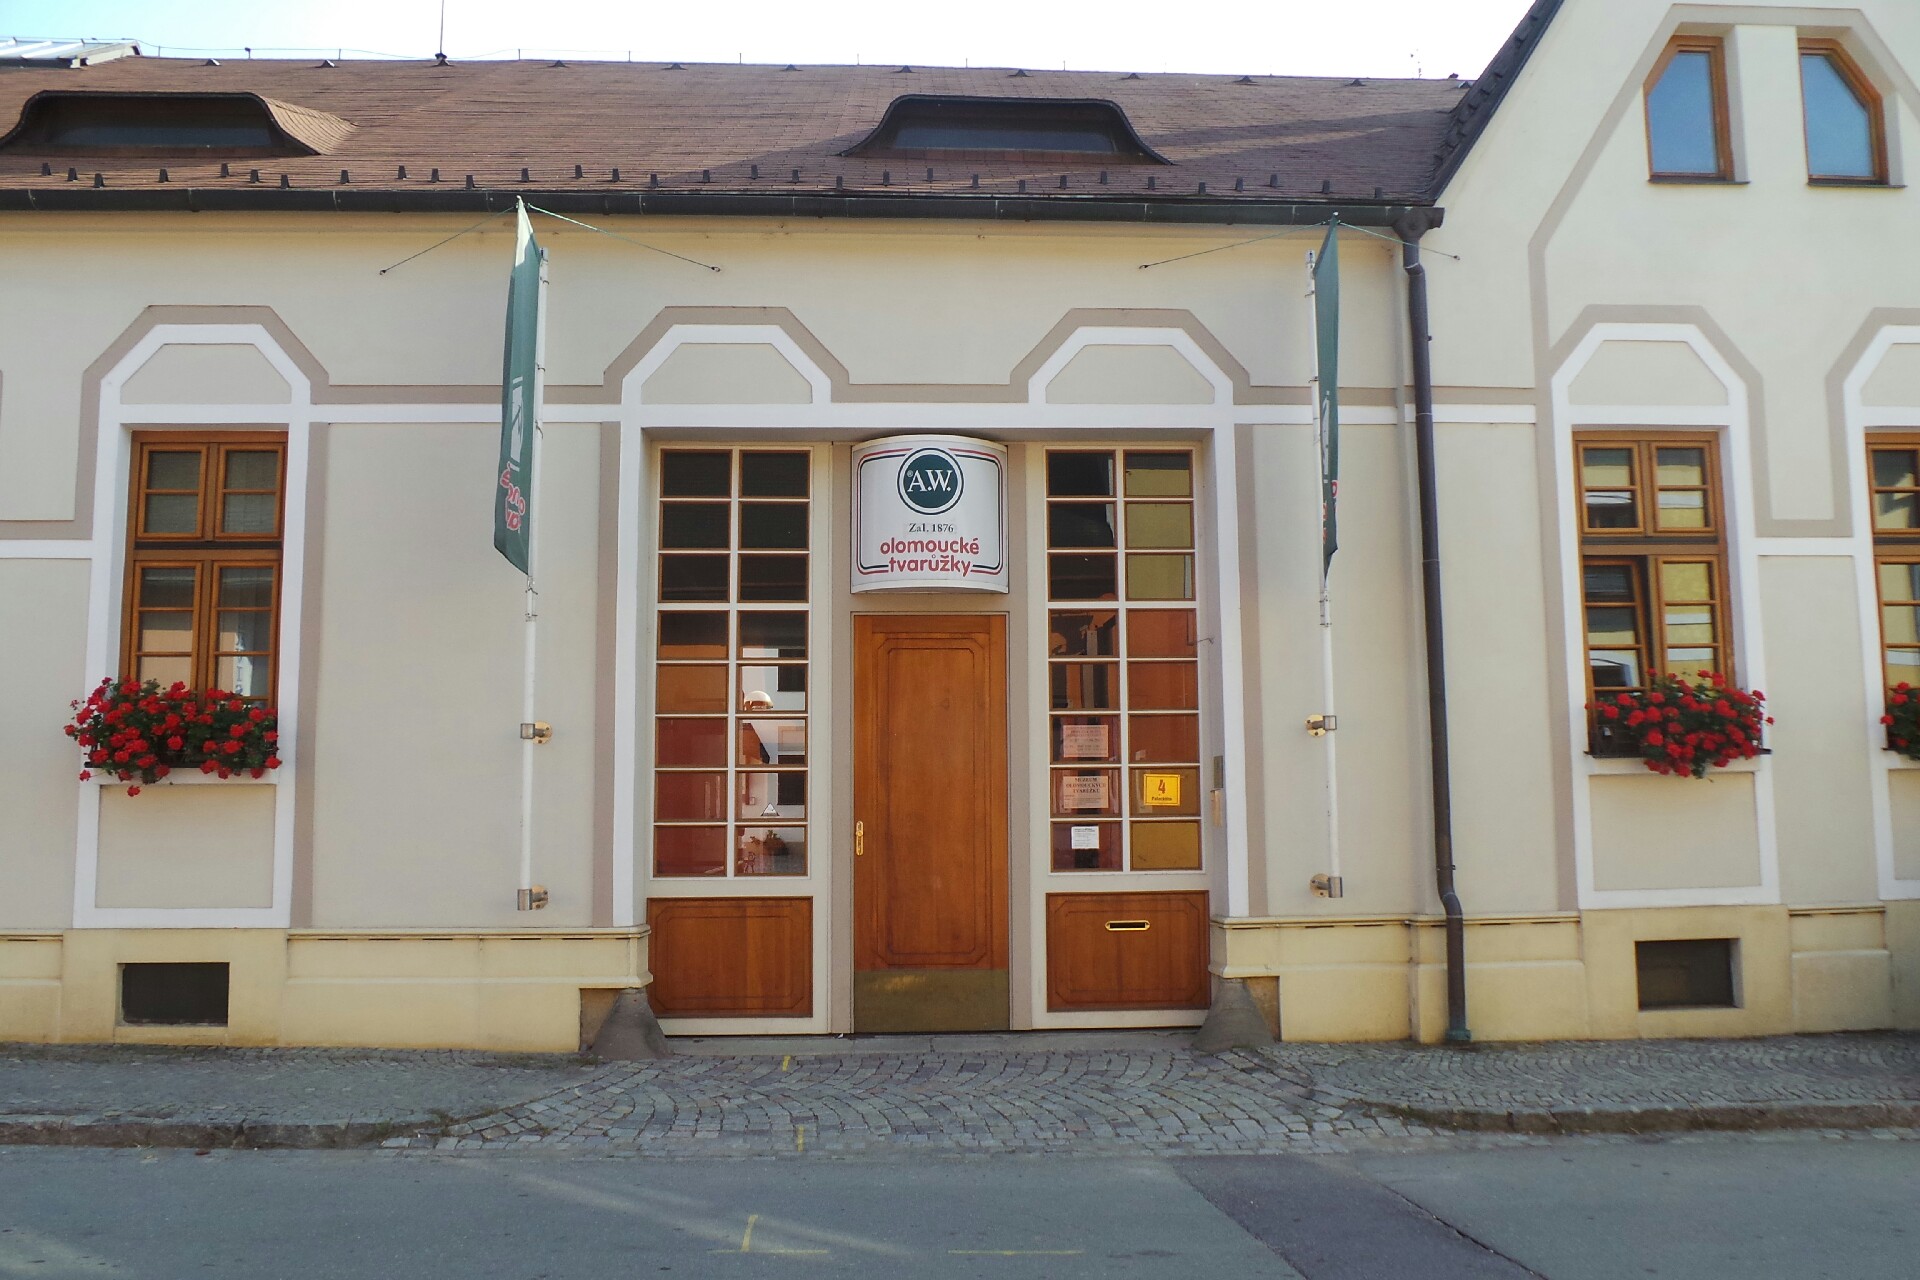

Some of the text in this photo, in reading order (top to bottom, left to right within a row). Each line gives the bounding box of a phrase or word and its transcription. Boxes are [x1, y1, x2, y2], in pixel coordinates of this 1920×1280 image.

[909, 523, 954, 533] Zal. 1876
[880, 536, 980, 555] olomoucké
[888, 554, 972, 577] tvarůžky
[1157, 779, 1166, 795] 4
